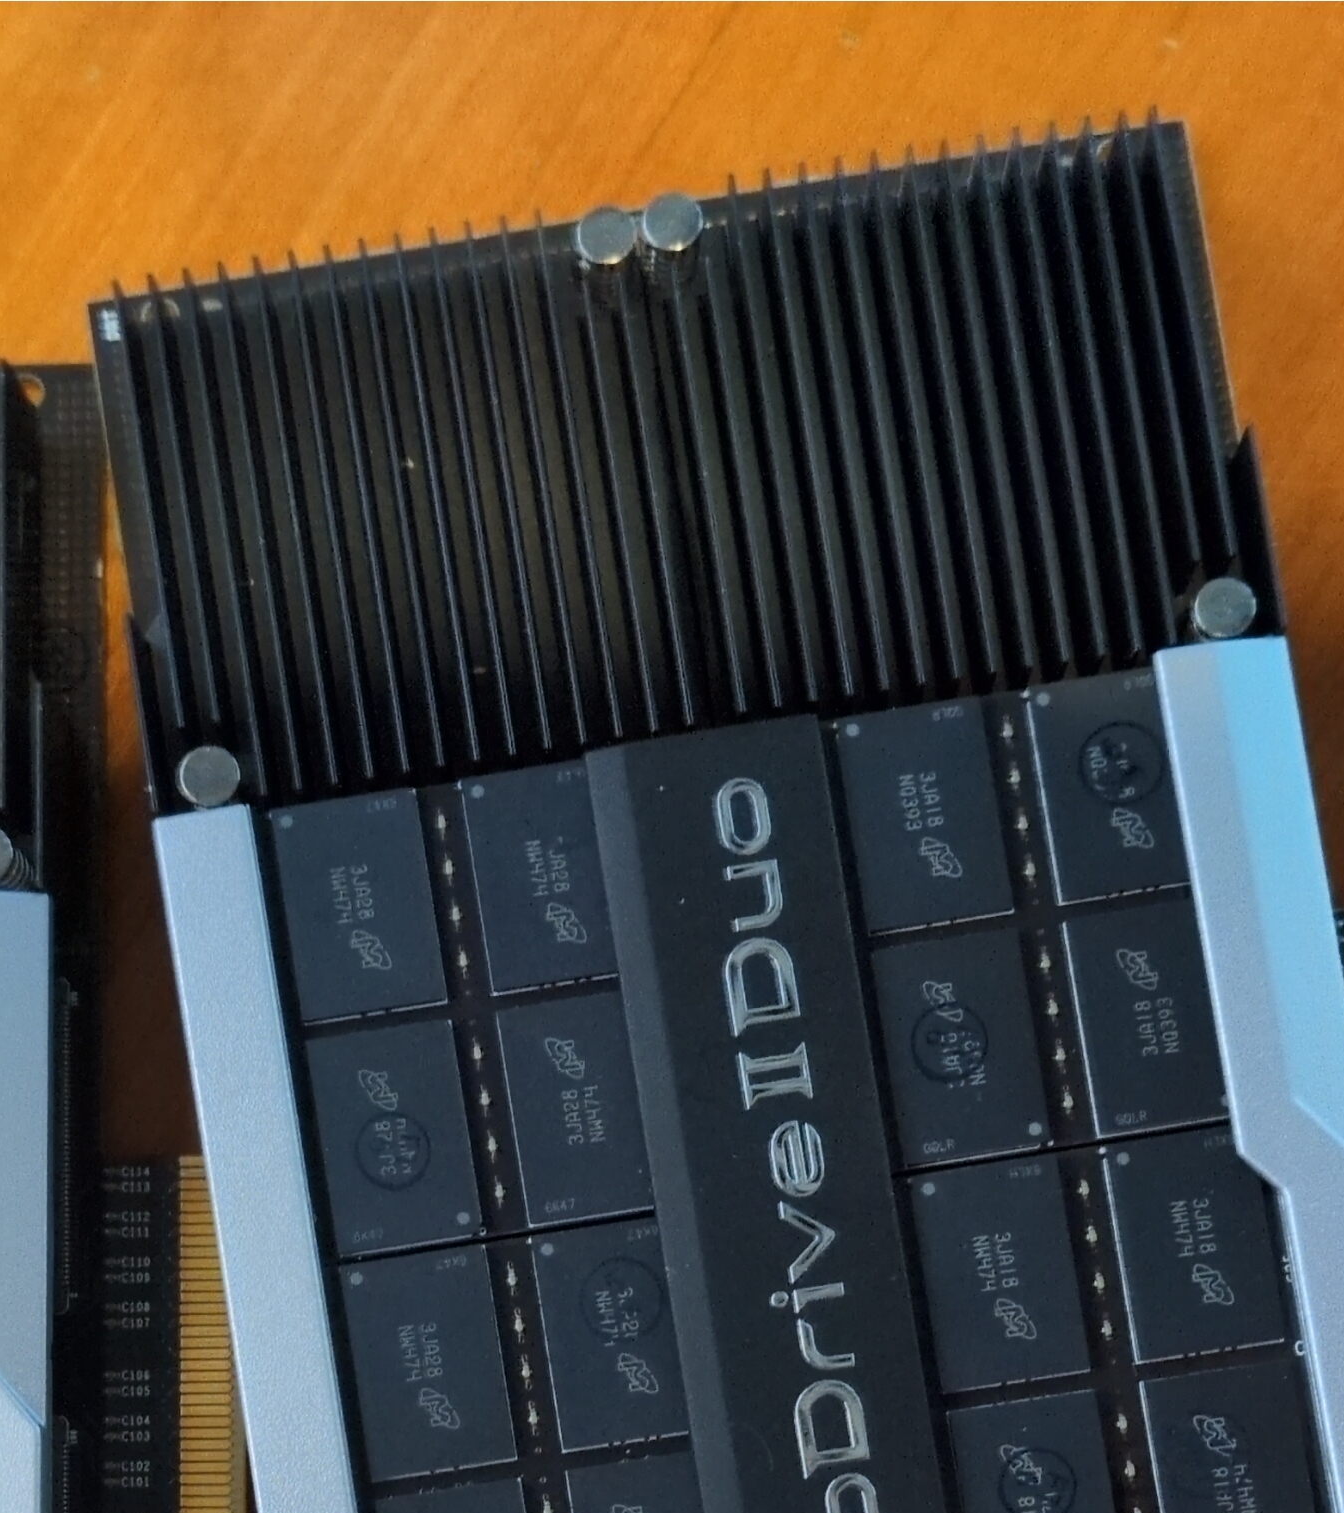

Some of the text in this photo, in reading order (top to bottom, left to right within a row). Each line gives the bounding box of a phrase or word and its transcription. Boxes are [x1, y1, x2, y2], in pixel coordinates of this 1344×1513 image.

[898, 774, 922, 831] NQ393
[919, 772, 944, 827] 3JA18
[330, 866, 353, 924] NW474
[350, 864, 375, 920] 3JA28
[525, 839, 548, 896] NW474
[1133, 1000, 1158, 1056] 3JA18
[1156, 997, 1179, 1054] NQ393
[562, 1089, 584, 1145] 3JA28
[584, 1085, 606, 1143] NW474
[1169, 1200, 1195, 1258] NW474
[1192, 1198, 1216, 1254] 3JA18
[972, 1235, 997, 1292] NW474
[994, 1232, 1019, 1288] 3JA18
[398, 1325, 421, 1382] NW474
[420, 1323, 443, 1377] 3JA28
